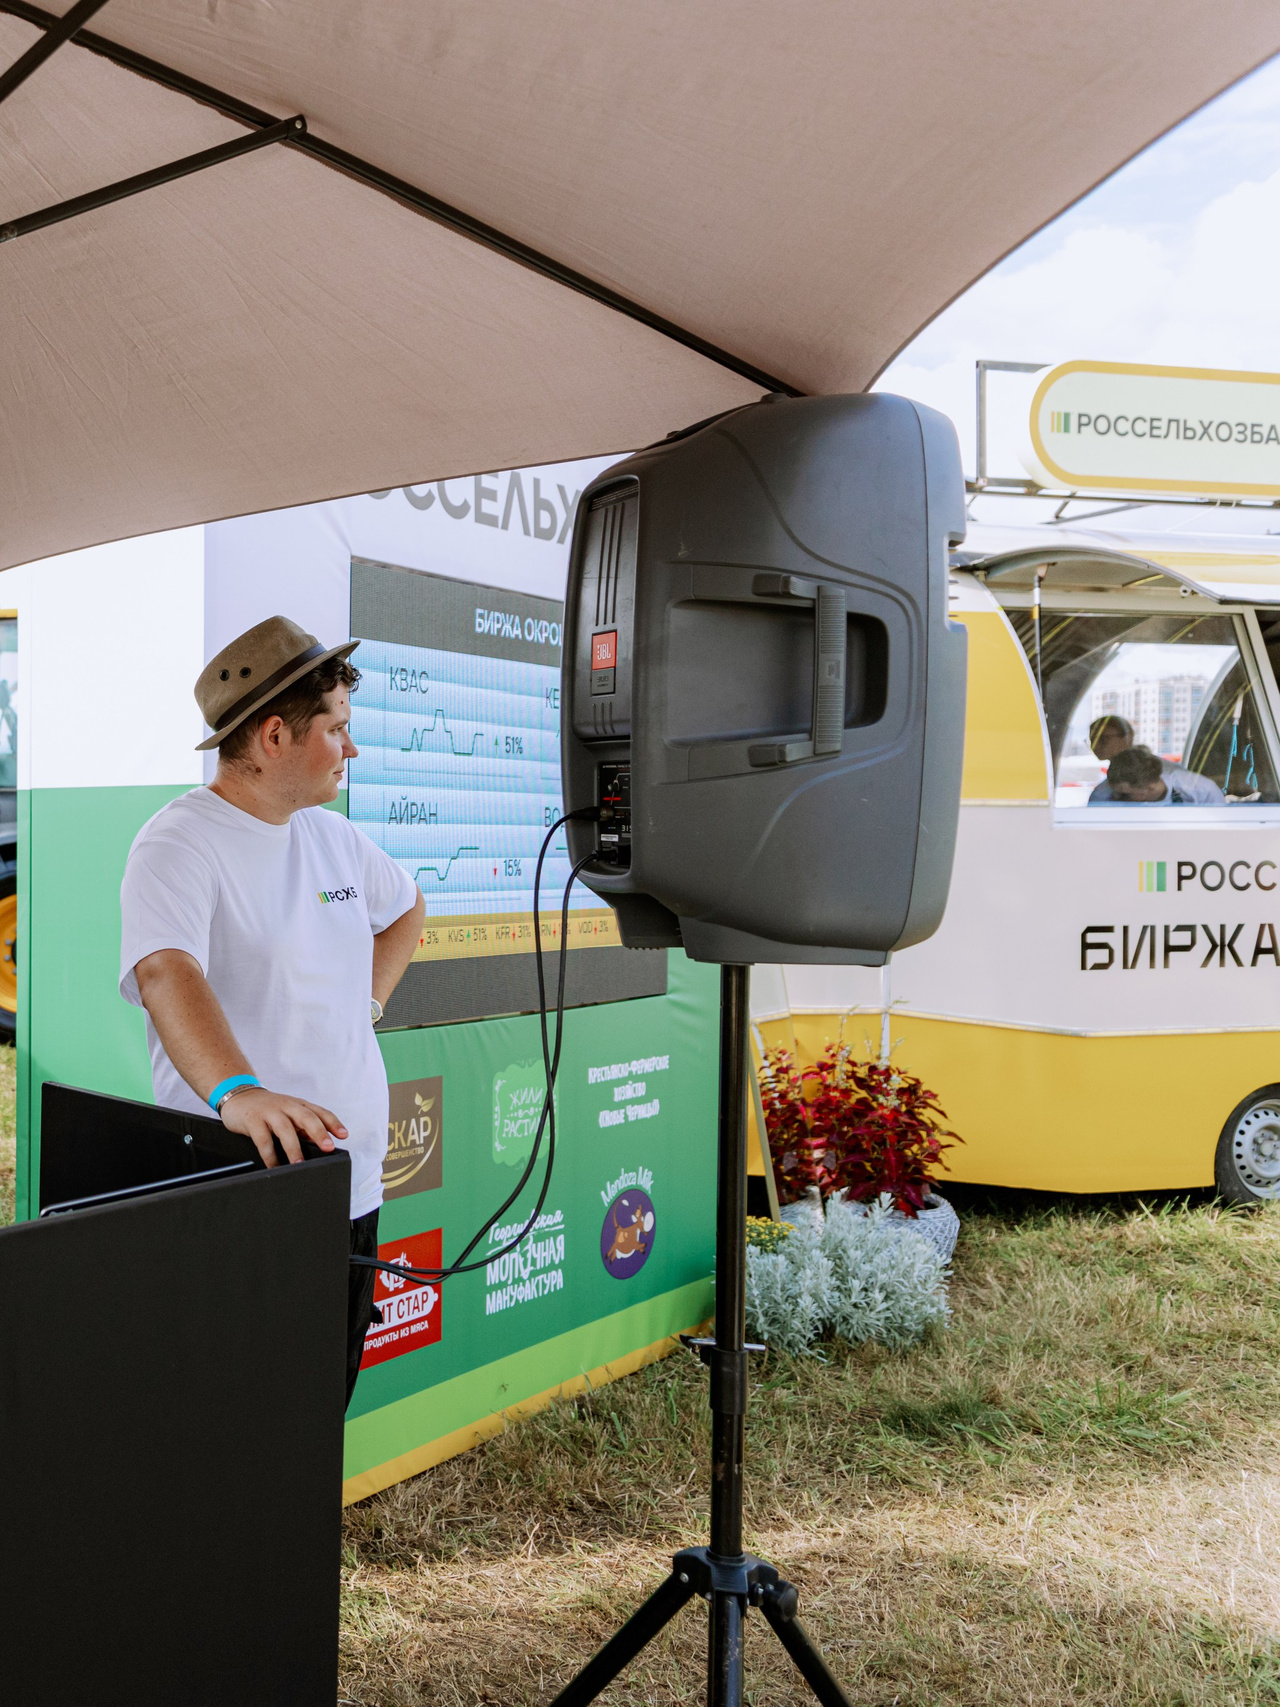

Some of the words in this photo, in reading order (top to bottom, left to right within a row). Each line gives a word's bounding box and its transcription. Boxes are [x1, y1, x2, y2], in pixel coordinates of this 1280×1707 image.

[1077, 411, 1280, 447] РОССЕЛЬХОЗБА
[475, 608, 522, 640] БИРЖА
[524, 617, 562, 647] ОКРО
[597, 643, 611, 660] JBL
[390, 666, 429, 694] КВАС
[505, 736, 523, 754] 51%
[388, 795, 438, 826] АЙРАН
[503, 859, 522, 877] 15%
[1176, 860, 1277, 892] РОСС
[328, 887, 358, 903] РСХБ
[426, 930, 439, 945] 3%
[448, 929, 465, 943] KVS
[473, 927, 488, 942] 51%
[1080, 922, 1280, 971] БИРЖА
[509, 1086, 543, 1110] ЖИЛИ
[397, 1291, 429, 1319] СТАР
[486, 1269, 564, 1315] МАНУФАКТУРА
[363, 1331, 399, 1351] ПРОДУКТЫ
[400, 1327, 410, 1338] ИЗ
[410, 1320, 429, 1334] МЯСА
